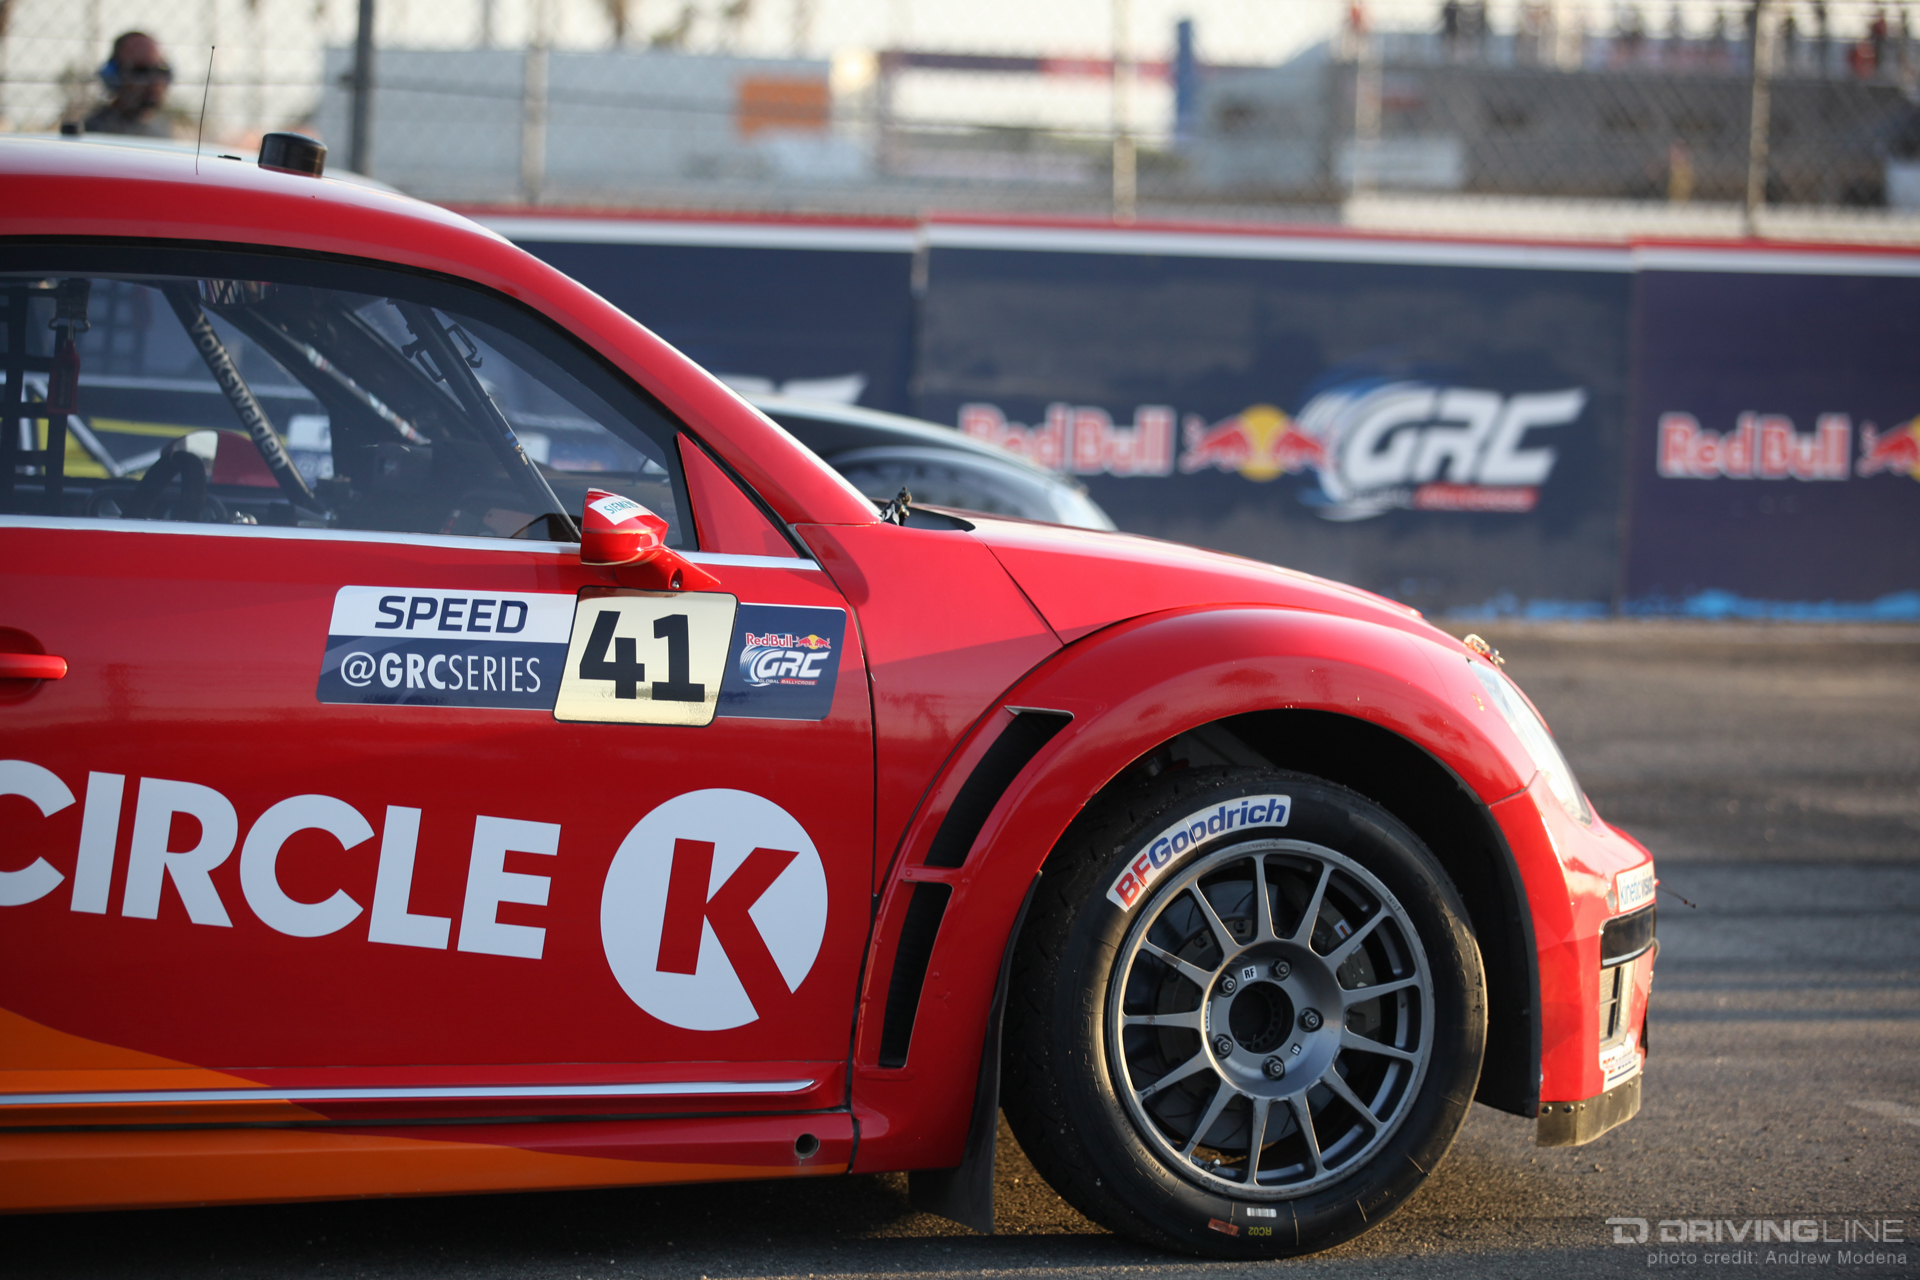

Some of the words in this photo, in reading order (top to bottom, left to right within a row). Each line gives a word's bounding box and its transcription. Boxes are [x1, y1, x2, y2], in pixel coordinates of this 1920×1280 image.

[191, 312, 289, 470] Volkswagen
[957, 402, 1067, 471] Red
[1069, 404, 1177, 477] Bull
[1347, 388, 1585, 488] GRC
[1656, 410, 1755, 479] Red
[1757, 413, 1850, 481] Bull
[374, 595, 529, 634] SPEED
[745, 632, 769, 647] Red
[770, 633, 793, 648] Bull
[340, 650, 542, 693] @GRCSERIES
[578, 610, 706, 703] 41
[756, 650, 831, 678] GRC
[1115, 798, 1287, 907] BFGoodrich
[0, 758, 562, 960] CIRCLE
[650, 832, 806, 1020] K
[1244, 967, 1256, 979] RF
[1247, 1226, 1273, 1236] RC02
